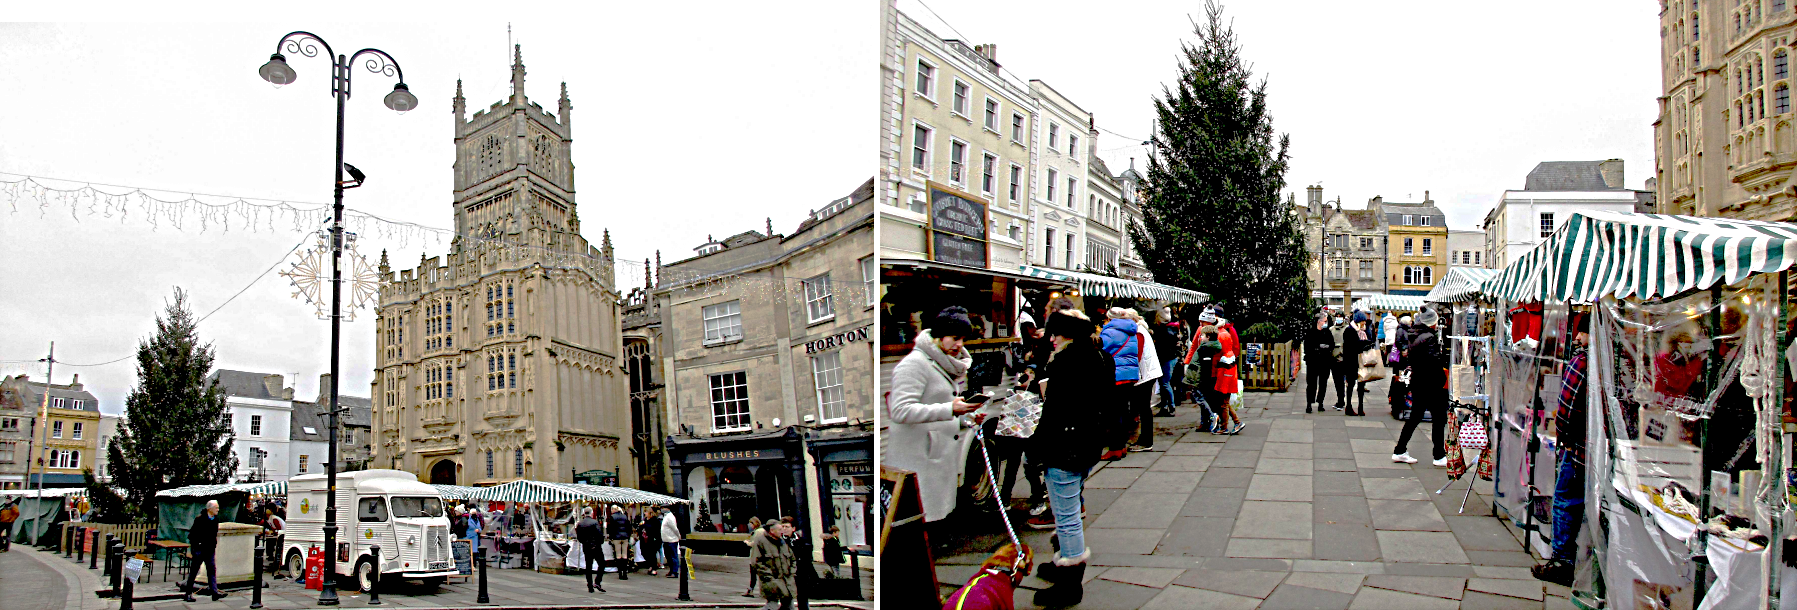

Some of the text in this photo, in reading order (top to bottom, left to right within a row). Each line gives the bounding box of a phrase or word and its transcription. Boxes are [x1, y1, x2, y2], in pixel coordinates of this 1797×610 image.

[958, 198, 985, 234] BURGERS
[805, 327, 868, 354] HORTON
[705, 450, 760, 460] BLUSHES
[839, 465, 874, 473] PERFUM
